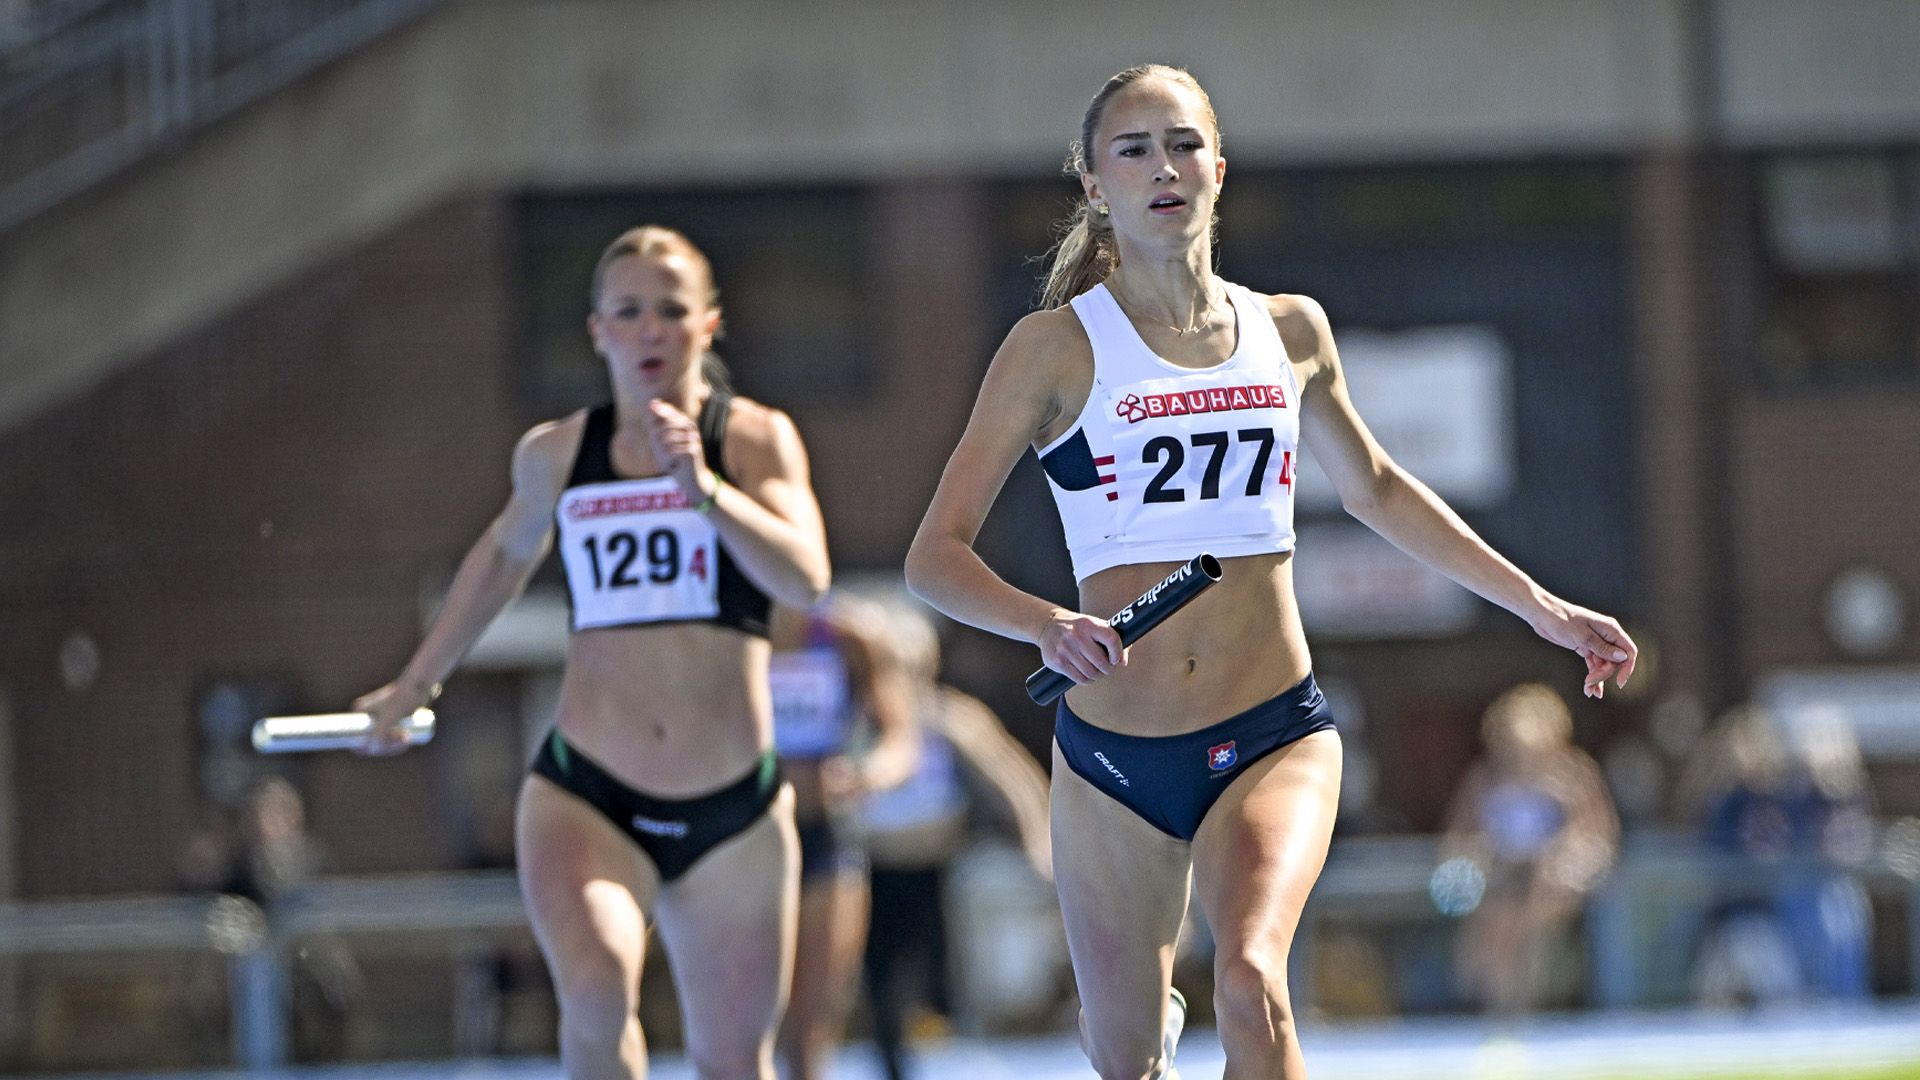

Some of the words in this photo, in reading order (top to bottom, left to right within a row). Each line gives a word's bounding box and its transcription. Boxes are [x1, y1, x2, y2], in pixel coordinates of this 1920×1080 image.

[1146, 386, 1285, 416] BAUHAUS
[1142, 427, 1275, 504] 277
[1279, 451, 1291, 495] 4
[583, 528, 680, 590] 129
[689, 546, 707, 581] 4
[1138, 562, 1193, 607] Nordic
[1094, 751, 1125, 780] CRAFT
